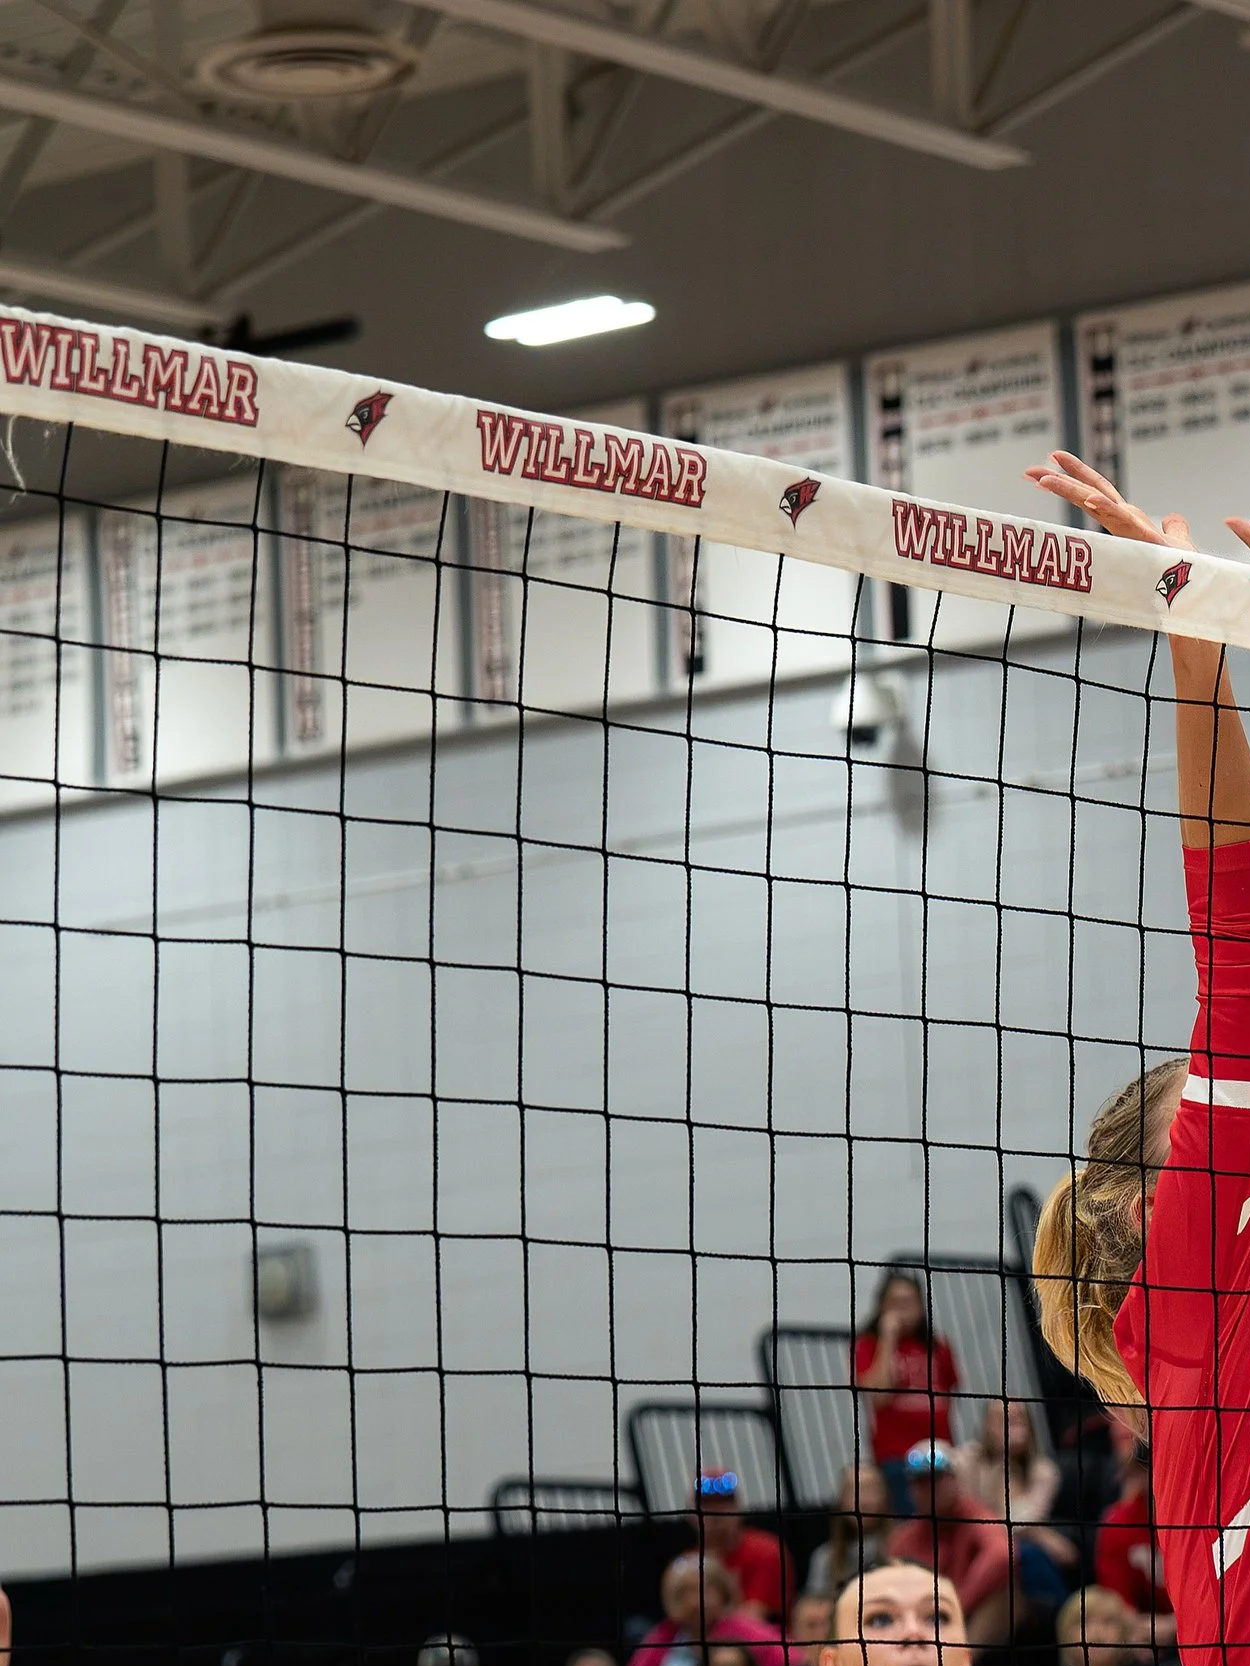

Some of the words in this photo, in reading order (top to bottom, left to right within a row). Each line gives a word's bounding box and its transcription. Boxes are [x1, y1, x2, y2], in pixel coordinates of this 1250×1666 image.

[0, 317, 259, 428] WILLMAR
[476, 409, 707, 508] WILLMAR
[892, 499, 1093, 593] WILLMAR
